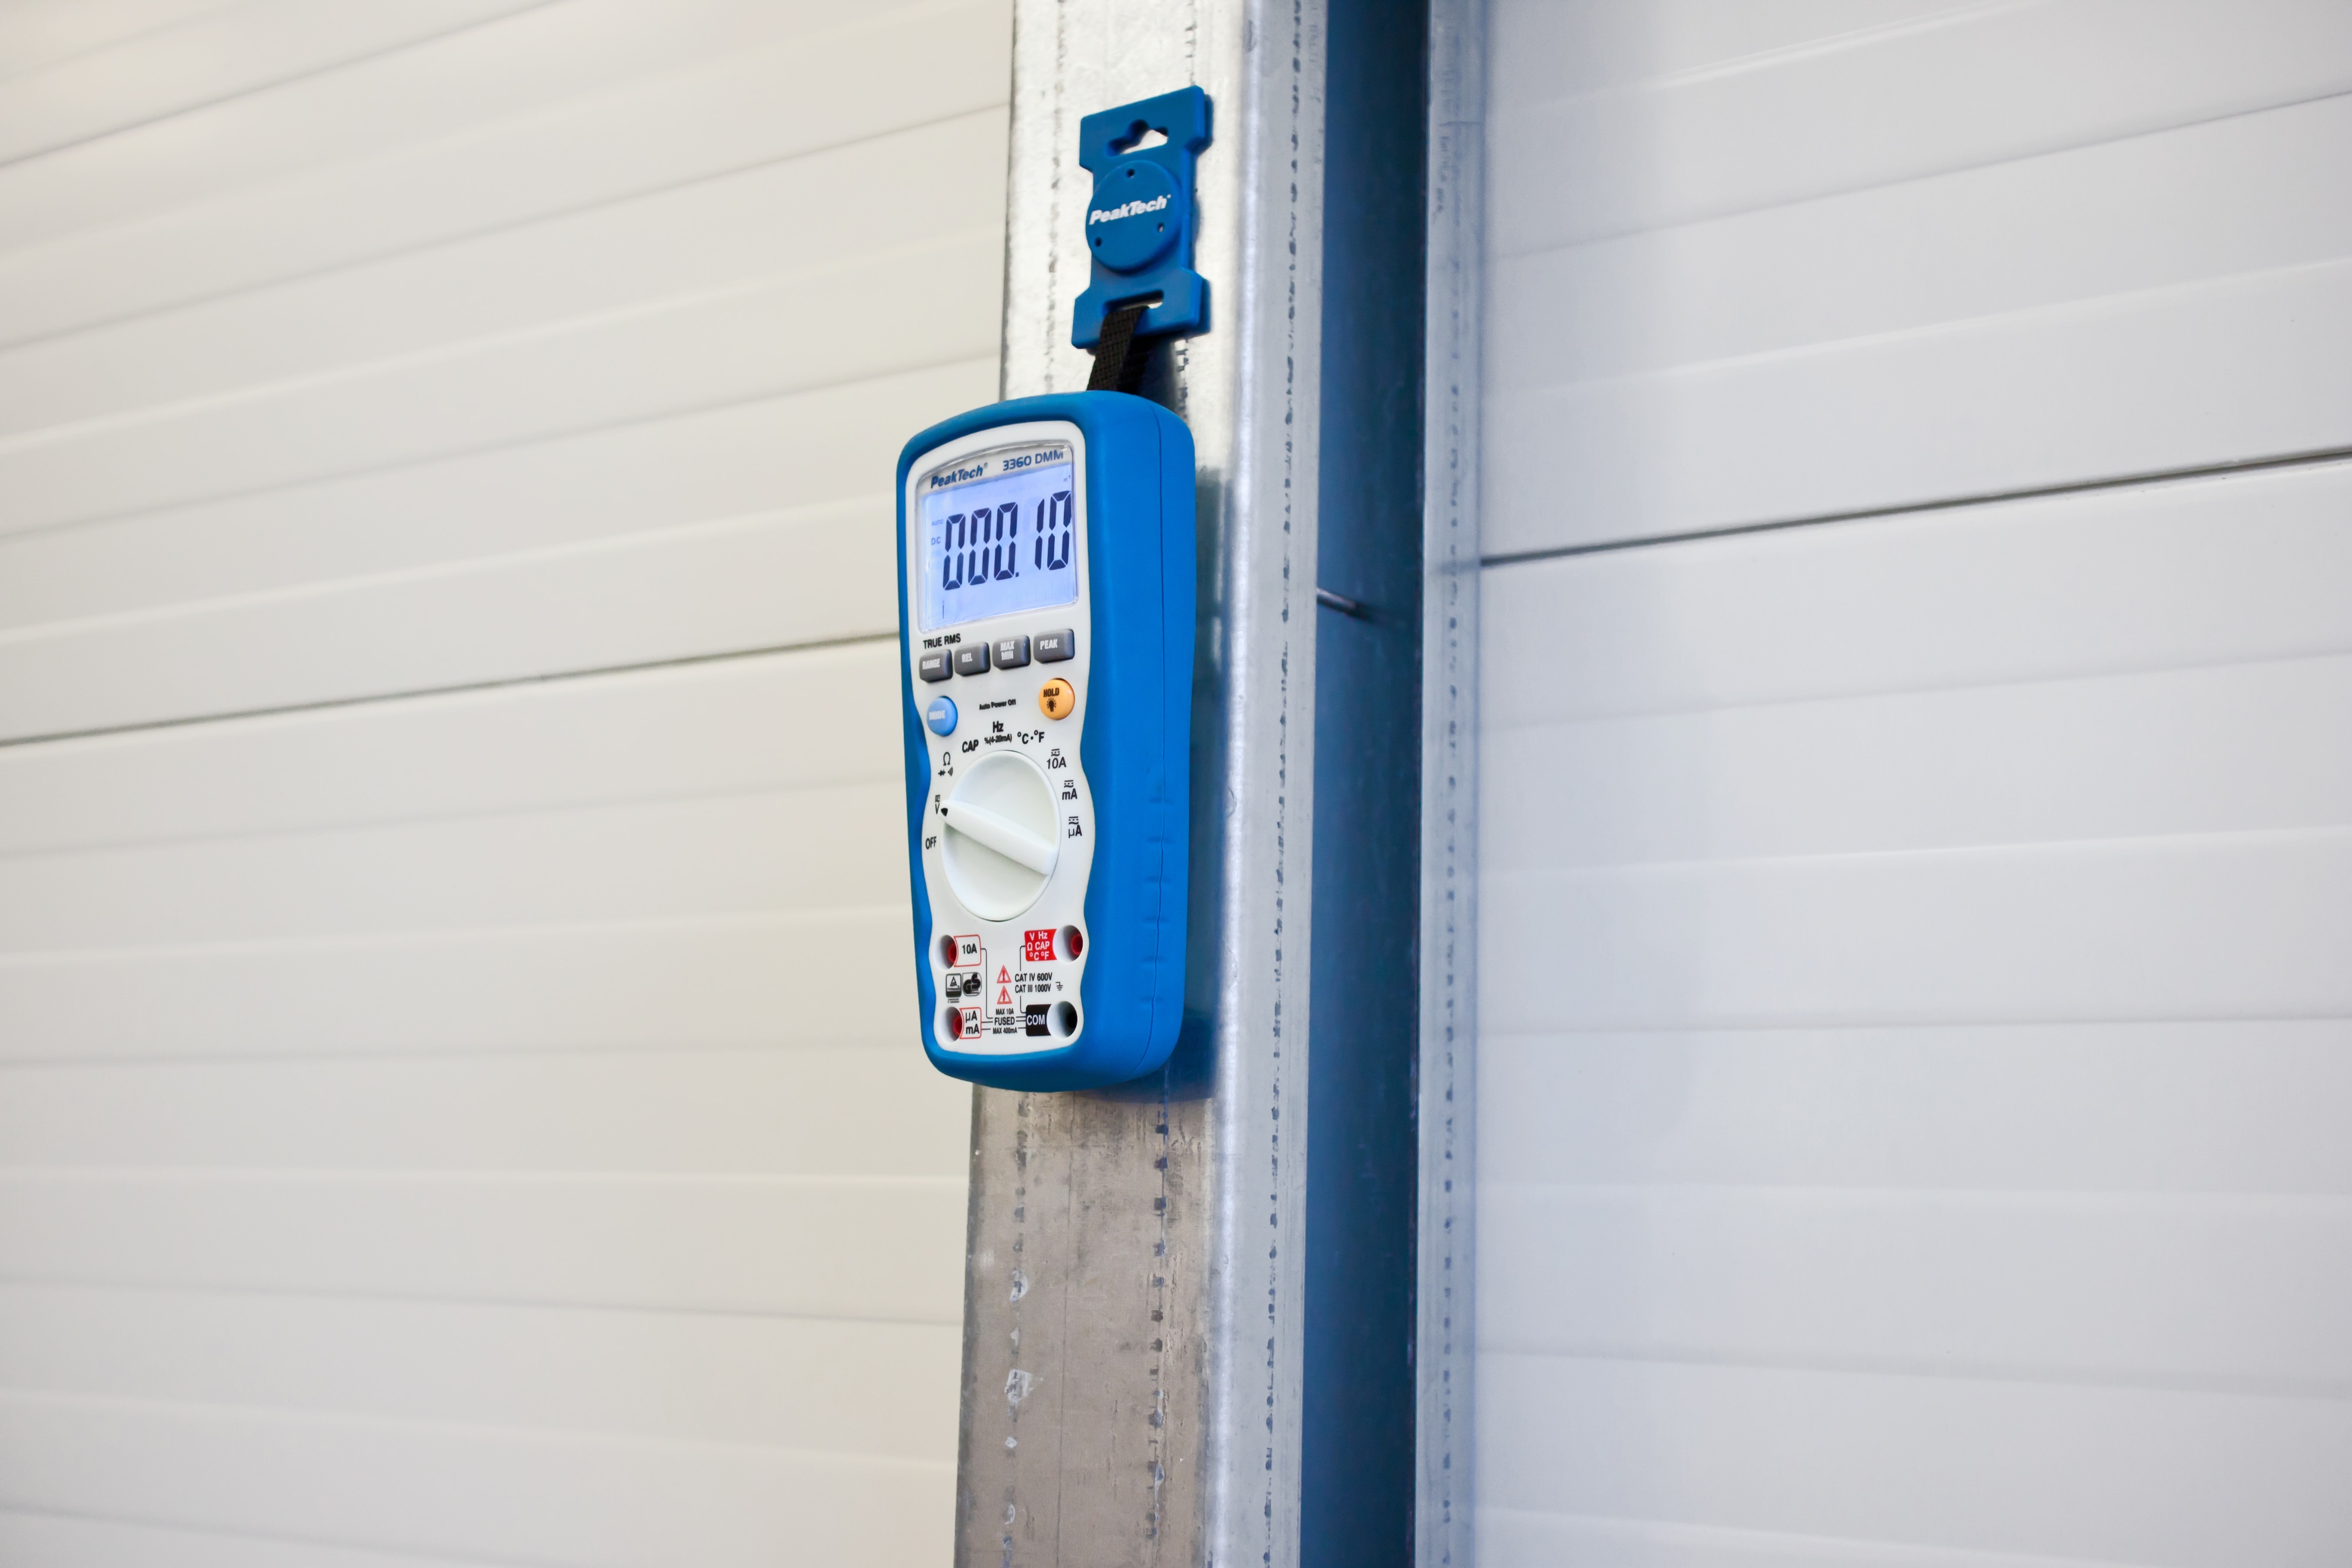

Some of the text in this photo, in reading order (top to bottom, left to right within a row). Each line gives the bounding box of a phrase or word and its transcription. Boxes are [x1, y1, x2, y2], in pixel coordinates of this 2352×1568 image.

[1003, 456, 1031, 471] 3360
[1035, 450, 1063, 464] DMM
[931, 536, 941, 545] DC
[923, 633, 961, 649] TRUE RMS
[1000, 640, 1015, 651] MAX
[1040, 639, 1058, 650] PEAK
[962, 653, 973, 663] REL
[1001, 650, 1014, 660] MIN
[922, 658, 940, 670] RANGE
[1043, 687, 1060, 697] HOLD
[929, 710, 946, 720] MODE
[993, 721, 1004, 733] Hz
[962, 739, 979, 753] CAP
[1047, 757, 1066, 769] 10A
[1062, 788, 1077, 800] mA
[926, 836, 937, 850] OFF
[1030, 931, 1048, 941] V Hz
[962, 943, 977, 954] 10A
[1035, 941, 1050, 950] CAP
[1015, 972, 1053, 982] CAT IV 600V
[1015, 985, 1027, 993] CAT
[1034, 984, 1051, 992] 1000V
[994, 1017, 1015, 1025] FUSED
[1027, 1015, 1045, 1025] COM
[965, 1024, 980, 1034] mA
